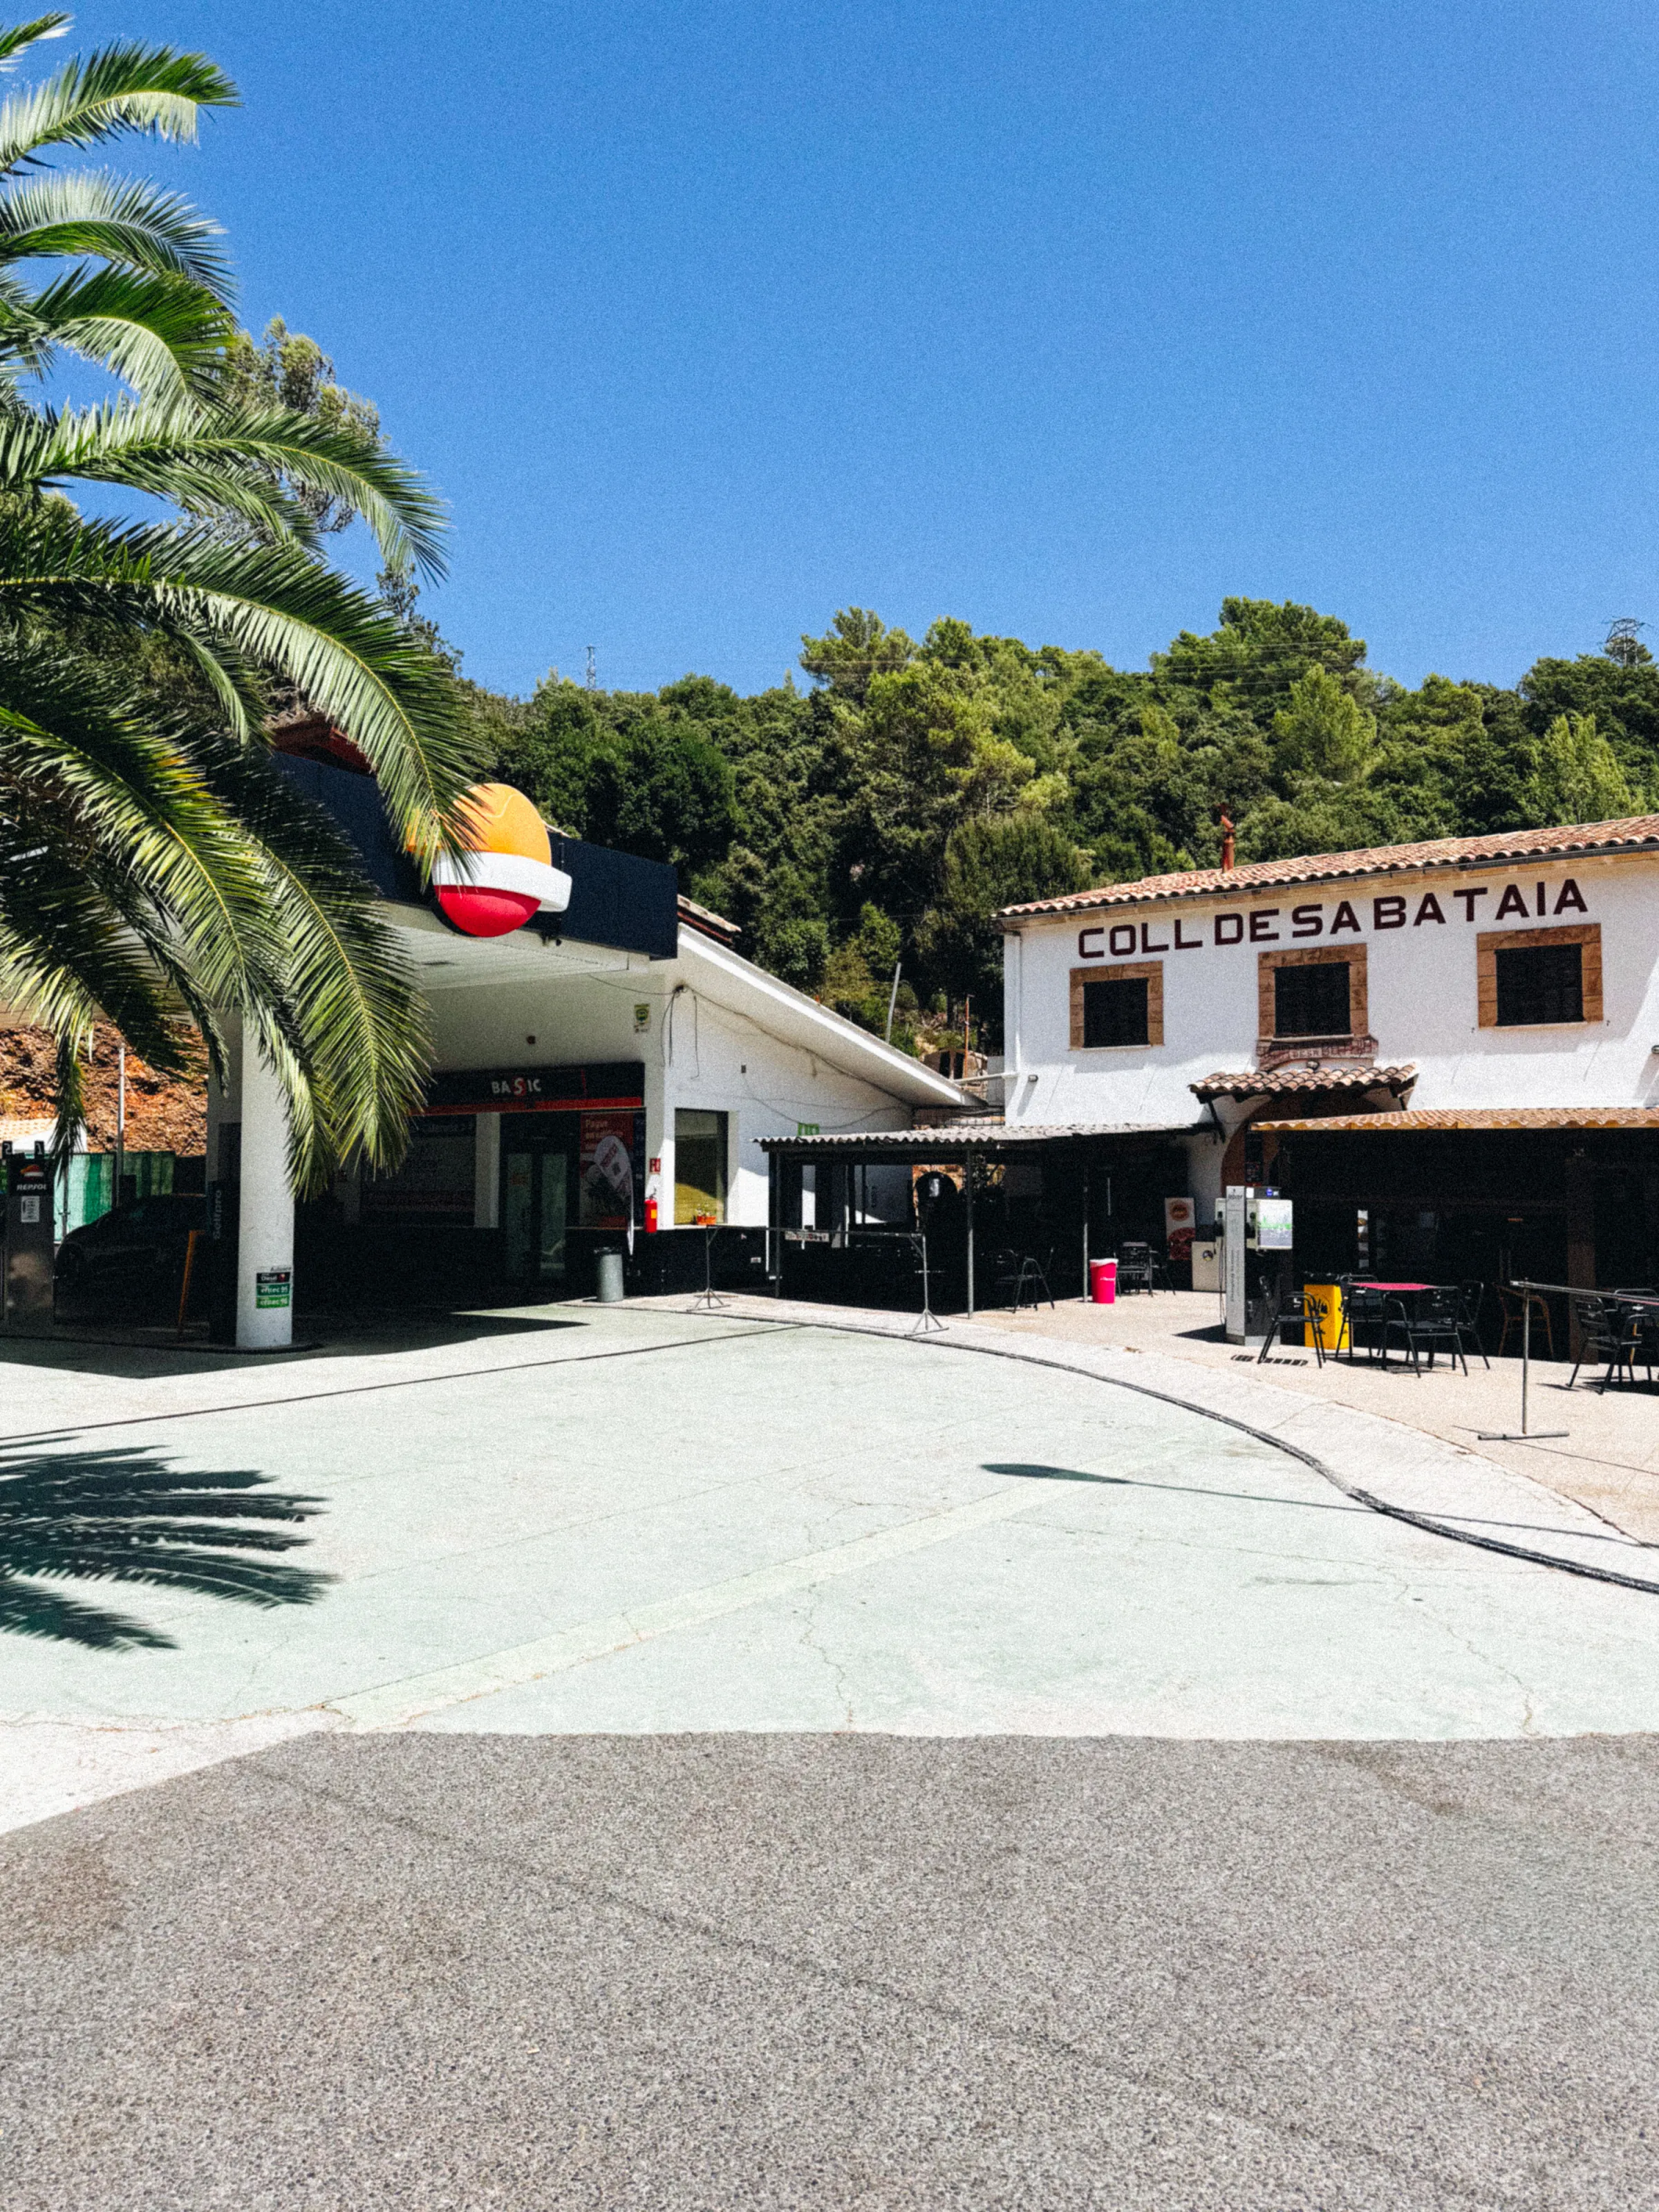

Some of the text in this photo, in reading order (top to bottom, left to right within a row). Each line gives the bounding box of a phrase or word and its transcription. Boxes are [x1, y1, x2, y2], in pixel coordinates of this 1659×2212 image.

[1078, 919, 1203, 959] COLL
[491, 1077, 542, 1095] BASIC
[35, 1143, 43, 1155] 1
